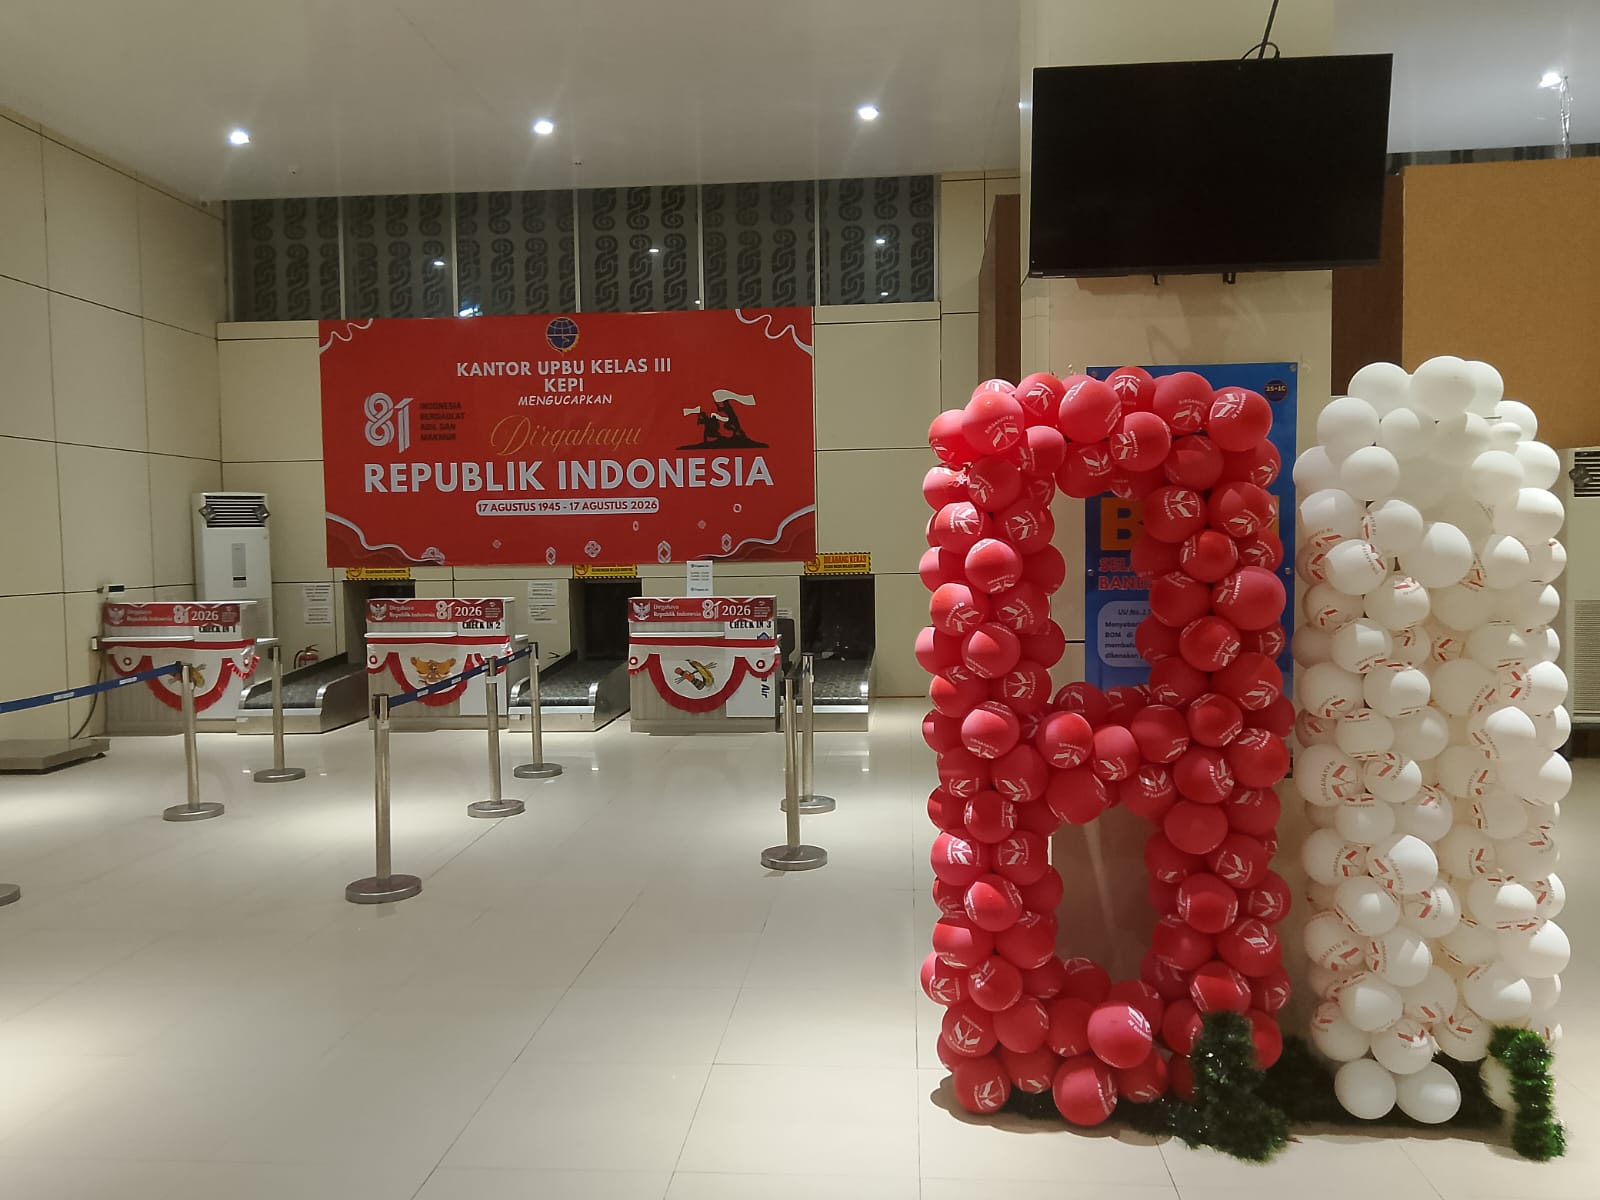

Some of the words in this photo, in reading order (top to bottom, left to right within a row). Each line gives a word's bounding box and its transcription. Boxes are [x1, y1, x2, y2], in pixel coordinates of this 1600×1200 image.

[457, 361, 532, 377] KANTOR
[537, 360, 585, 375] UPBU
[591, 358, 648, 374] KELAS
[654, 357, 671, 372] III
[544, 378, 584, 393] KEPI
[518, 394, 613, 406] MENGUCAPKAN
[364, 392, 414, 453] 81
[491, 414, 642, 456] Dirgahayu
[364, 461, 545, 493] REPUBLIK
[558, 456, 774, 490] INDONESIA
[478, 503, 490, 512] 17
[490, 502, 536, 512] AGUSTUS
[538, 502, 561, 511] 1945
[569, 502, 579, 511] 17
[582, 501, 628, 510] AGUSTUS
[630, 500, 657, 510] 2026
[191, 610, 219, 621] 2026
[454, 606, 482, 617] 2026
[722, 605, 751, 616] 2026
[462, 621, 485, 630] CHECK
[495, 621, 500, 630] 2
[729, 620, 754, 629] CHECK
